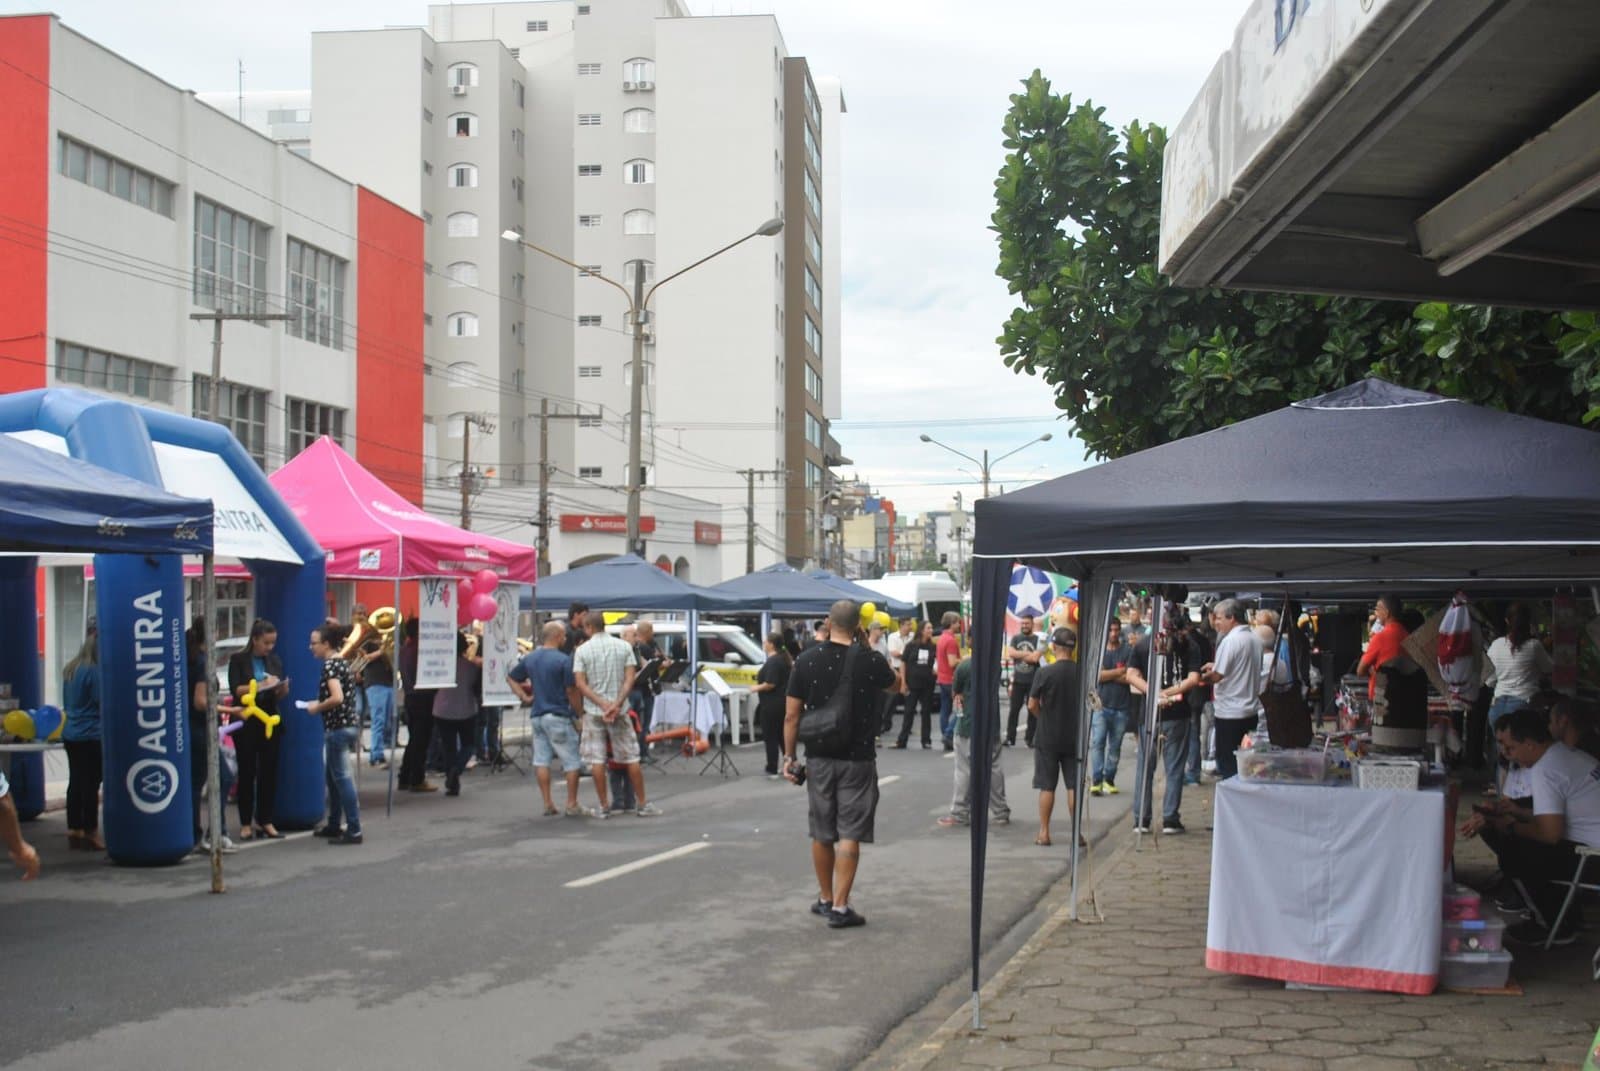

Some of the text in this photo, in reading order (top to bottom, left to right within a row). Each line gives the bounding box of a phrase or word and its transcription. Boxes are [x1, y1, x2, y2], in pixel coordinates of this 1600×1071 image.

[215, 508, 269, 533] ENTRA
[593, 517, 628, 529] Santand
[133, 589, 167, 753] ACENTRA
[173, 664, 181, 678] DE
[174, 681, 184, 753] COOPERATIVA
